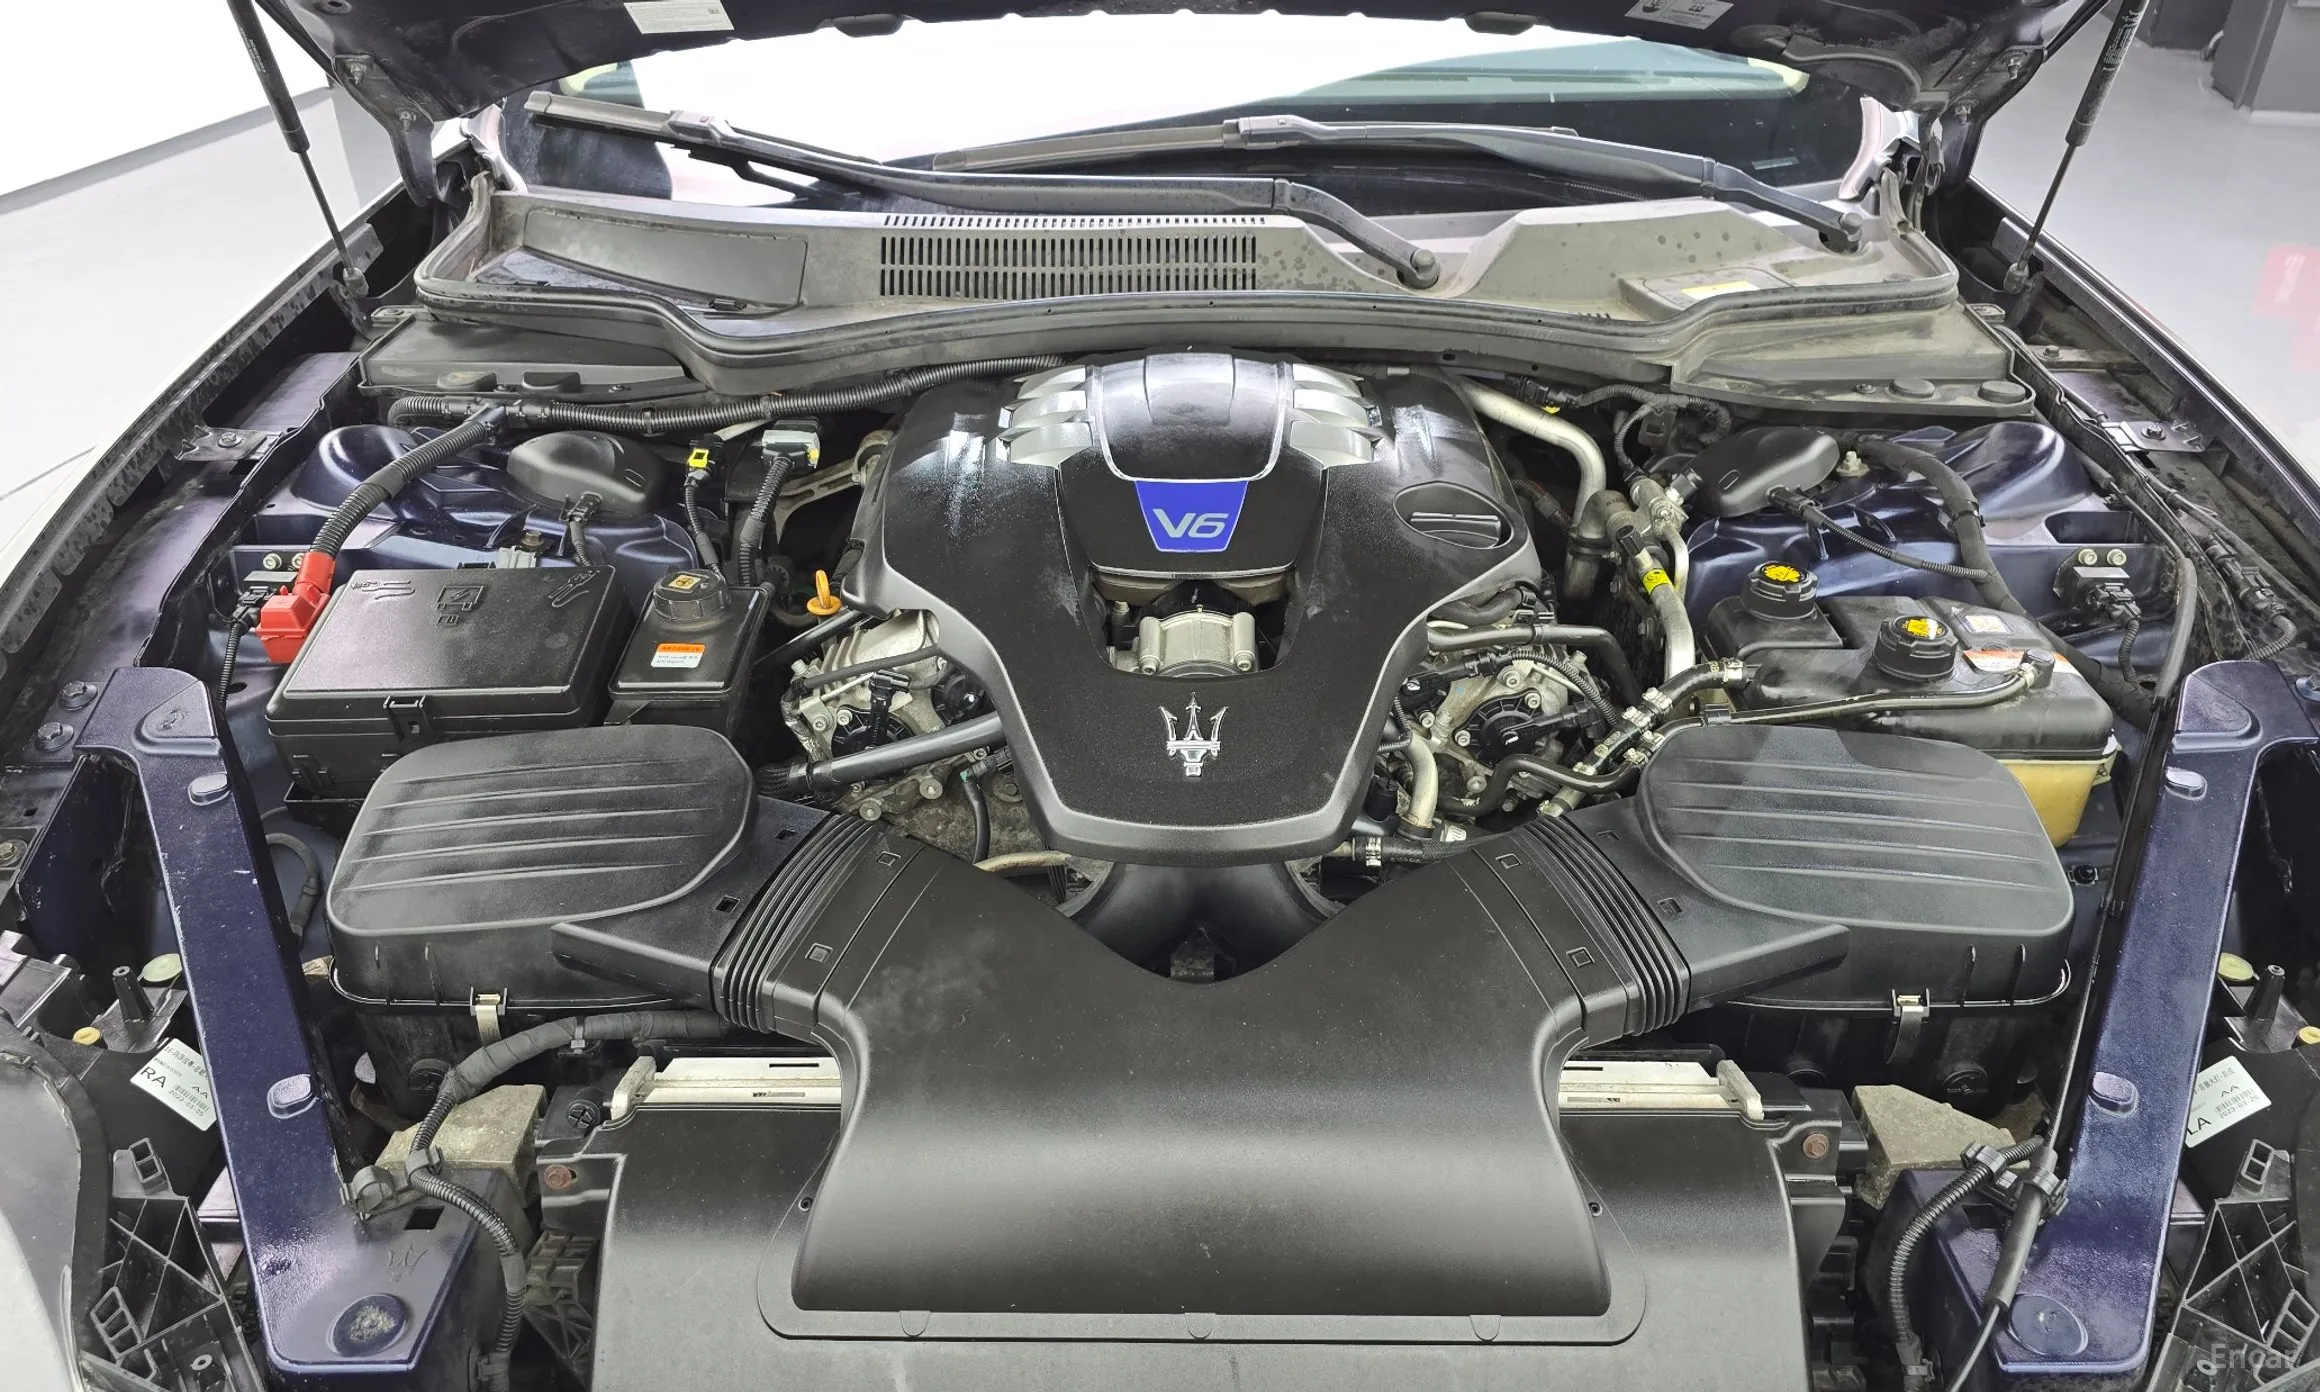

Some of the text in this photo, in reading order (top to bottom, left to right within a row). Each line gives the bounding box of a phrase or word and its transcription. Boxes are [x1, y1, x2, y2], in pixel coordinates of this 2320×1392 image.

[1152, 508, 1229, 538] V6
[140, 1066, 167, 1088] RA
[2186, 1117, 2212, 1135] LA
